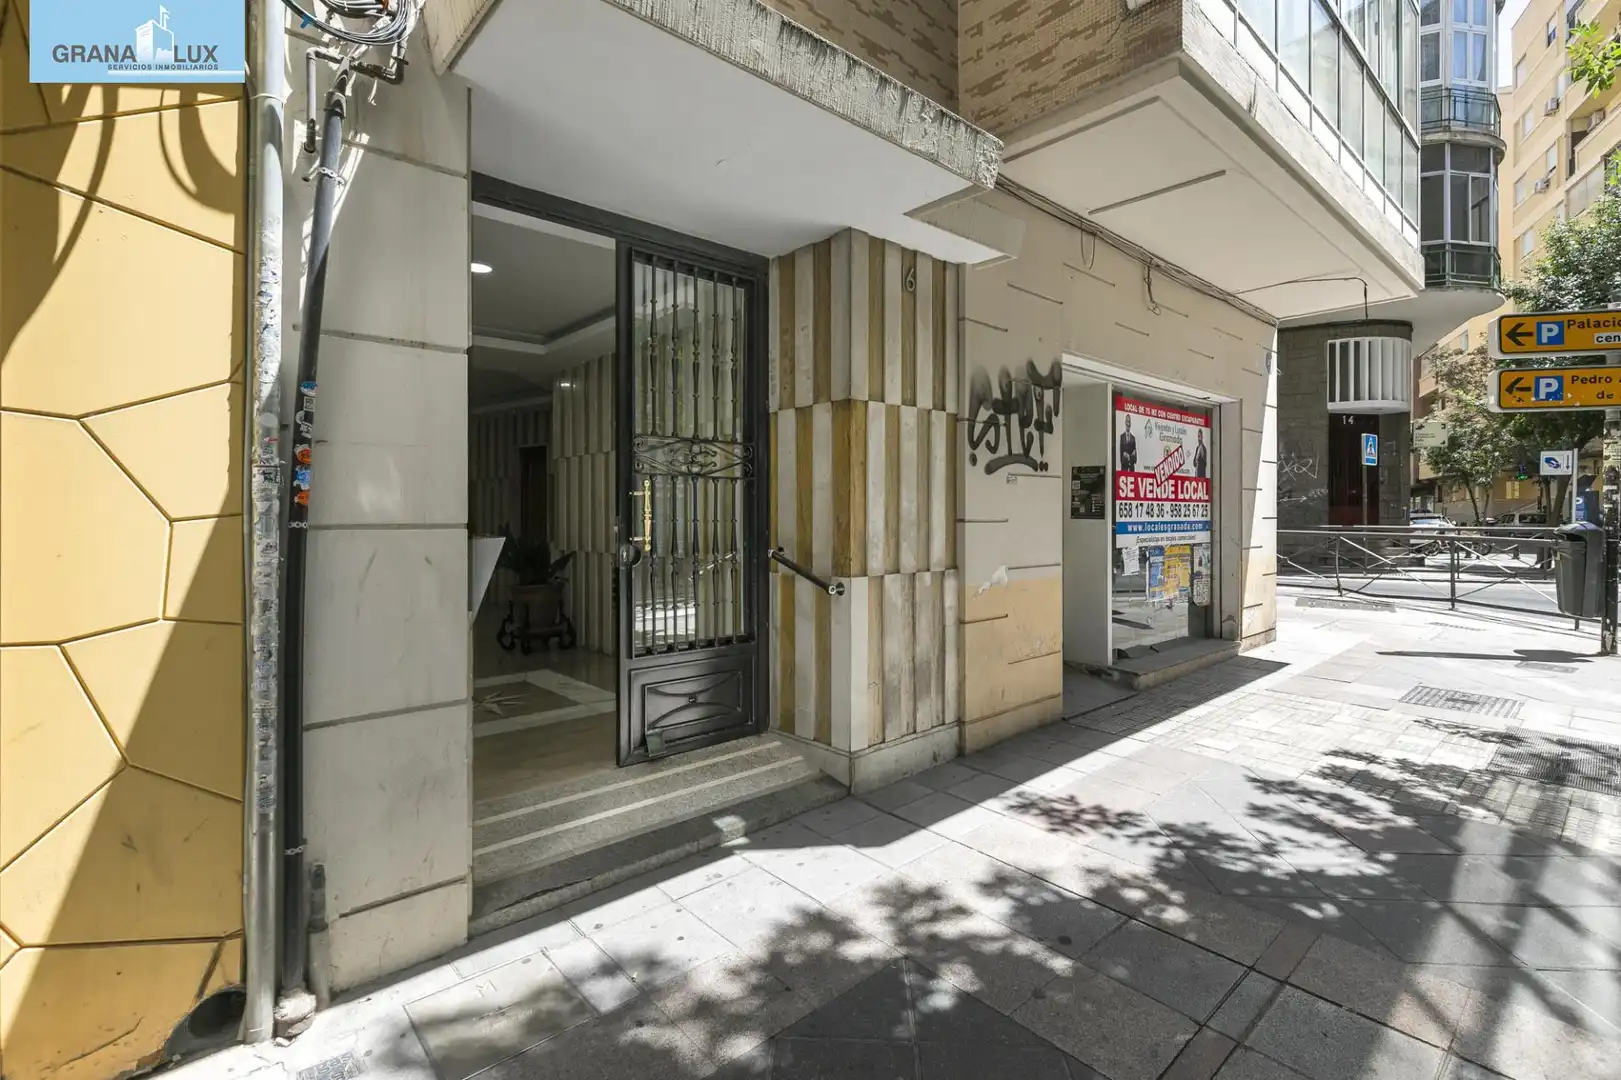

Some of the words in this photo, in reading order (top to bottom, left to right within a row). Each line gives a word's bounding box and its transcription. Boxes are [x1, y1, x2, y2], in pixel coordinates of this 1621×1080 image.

[905, 267, 916, 292] 6
[1595, 334, 1621, 343] cen
[1571, 374, 1613, 385] Pedro
[1596, 390, 1614, 400] de
[1124, 402, 1138, 412] LOCAL
[1342, 415, 1354, 425] 14
[1154, 447, 1184, 483] VENDIDO
[1119, 475, 1135, 498] SE
[1138, 477, 1176, 499] VENDE
[1178, 480, 1209, 500] LOCAL
[1119, 502, 1133, 518] 658
[1135, 502, 1144, 518] 17
[1145, 503, 1155, 518] 48
[1156, 503, 1165, 518] 36
[1169, 503, 1182, 518] 958
[1183, 503, 1191, 518] 25
[1192, 503, 1200, 518] 67
[1201, 503, 1209, 518] 25
[1127, 522, 1203, 533] www.localesgranada.com
